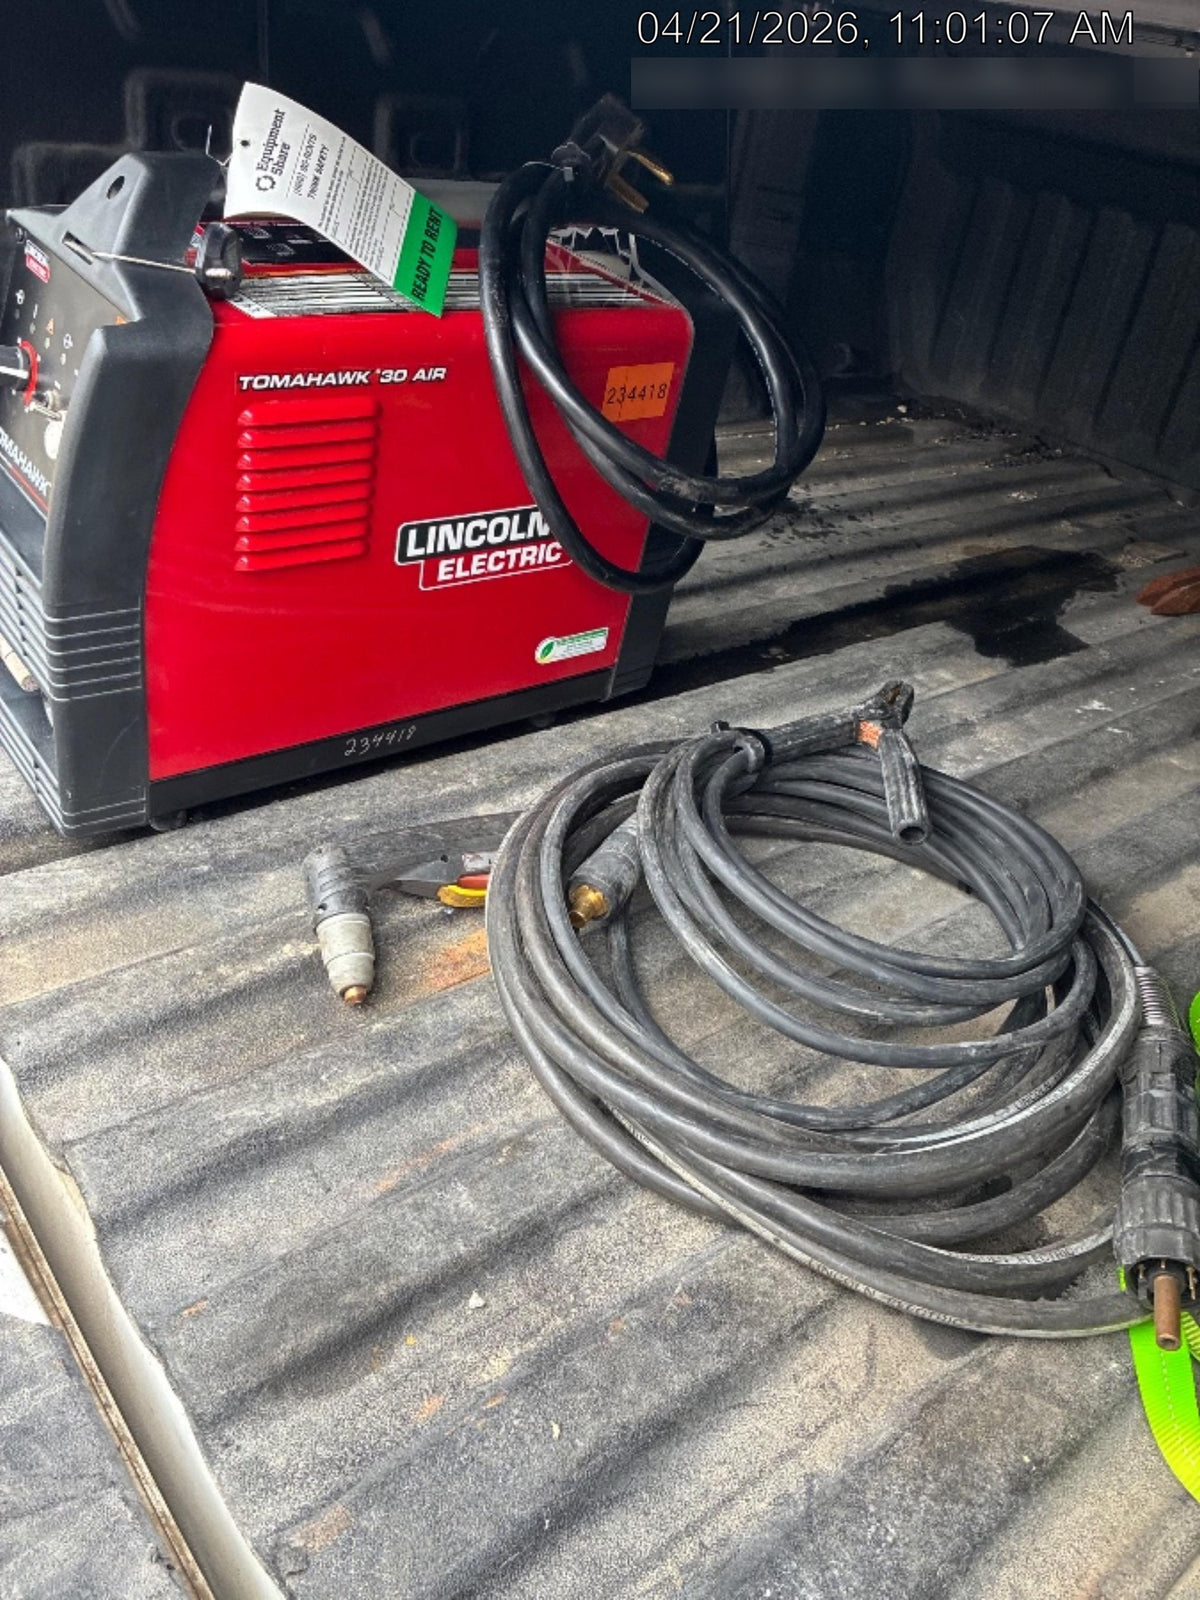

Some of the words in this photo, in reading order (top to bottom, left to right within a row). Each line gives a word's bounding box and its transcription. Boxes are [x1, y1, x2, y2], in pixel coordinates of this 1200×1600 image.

[256, 107, 286, 172] Equipment
[271, 142, 291, 176] Share
[315, 143, 330, 175] SAFETY
[424, 205, 443, 243] RENT
[424, 240, 437, 260] TO
[411, 257, 433, 301] READY
[239, 370, 371, 390] TOMAHAWK
[412, 367, 447, 382] AIR
[606, 383, 668, 405] 234418
[406, 510, 551, 558] LINCOLN
[437, 541, 562, 582] ELECTRIC
[344, 725, 417, 757] 234418
